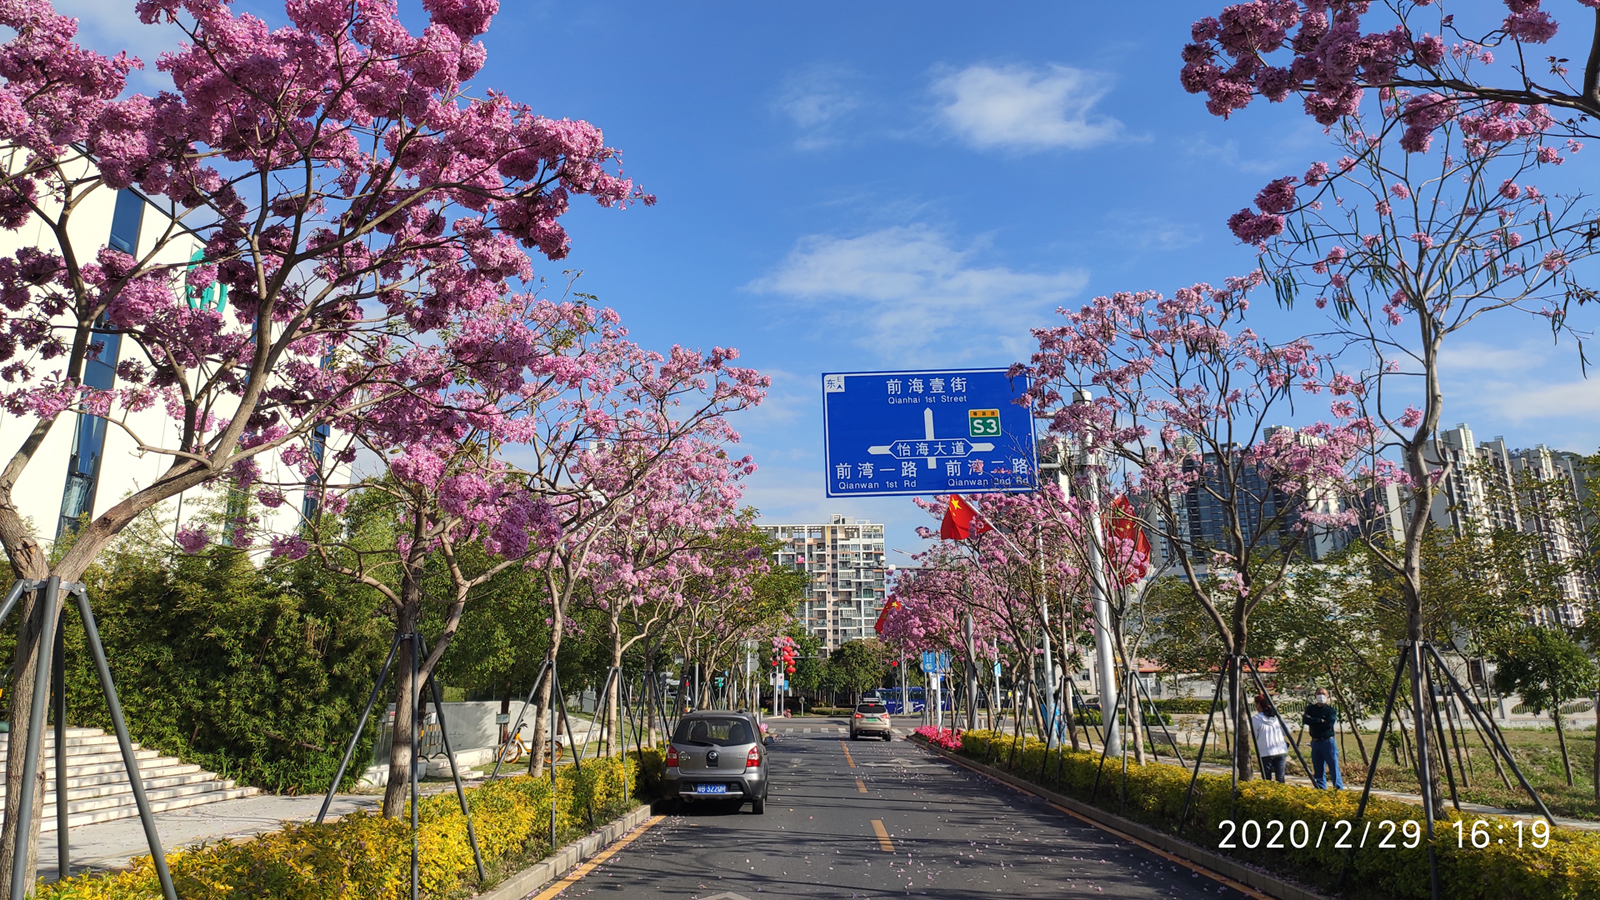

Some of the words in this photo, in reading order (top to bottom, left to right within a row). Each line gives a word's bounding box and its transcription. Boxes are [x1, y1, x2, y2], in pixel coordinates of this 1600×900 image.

[826, 379, 836, 389] 东
[886, 376, 967, 395] 前海壹街
[887, 396, 921, 405] Qianhai
[940, 395, 967, 403] Street
[972, 418, 998, 433] S3
[897, 441, 967, 457] 怡海大道
[835, 460, 918, 480] 前湾一路
[838, 481, 879, 490] Qianwan
[903, 480, 917, 488] Rd
[948, 478, 989, 487] Qianwan
